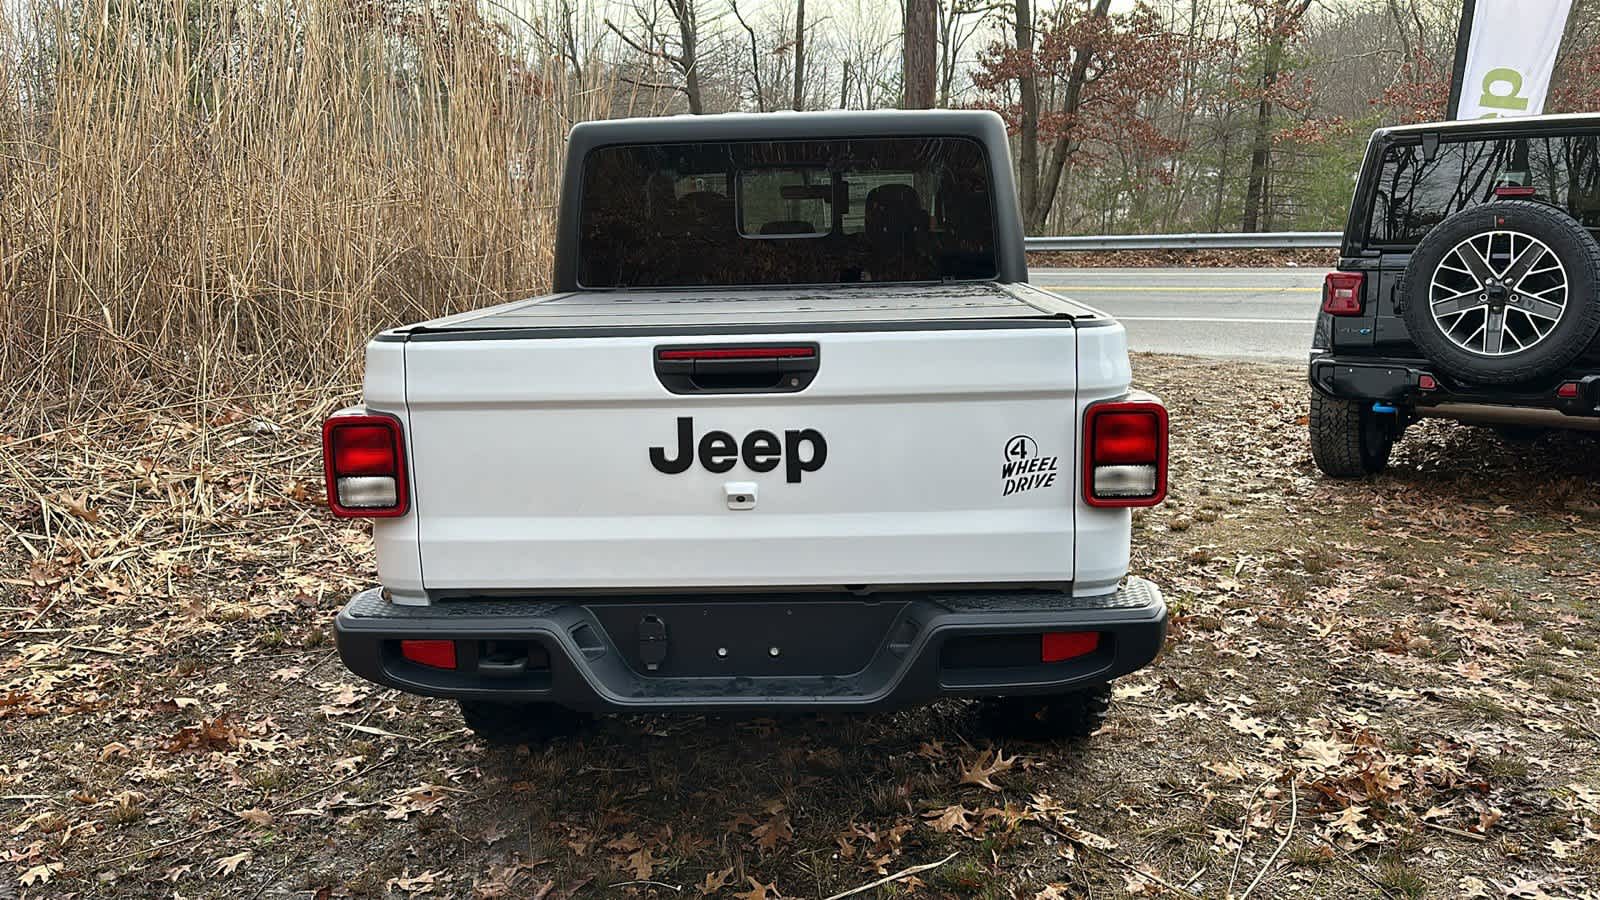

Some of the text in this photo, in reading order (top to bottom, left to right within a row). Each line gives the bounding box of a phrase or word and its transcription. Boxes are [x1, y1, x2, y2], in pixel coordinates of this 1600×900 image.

[649, 417, 827, 484] Jeep
[1010, 439, 1028, 459] 4
[1002, 456, 1058, 479] WHEEL
[1003, 473, 1057, 496] DRIVE
